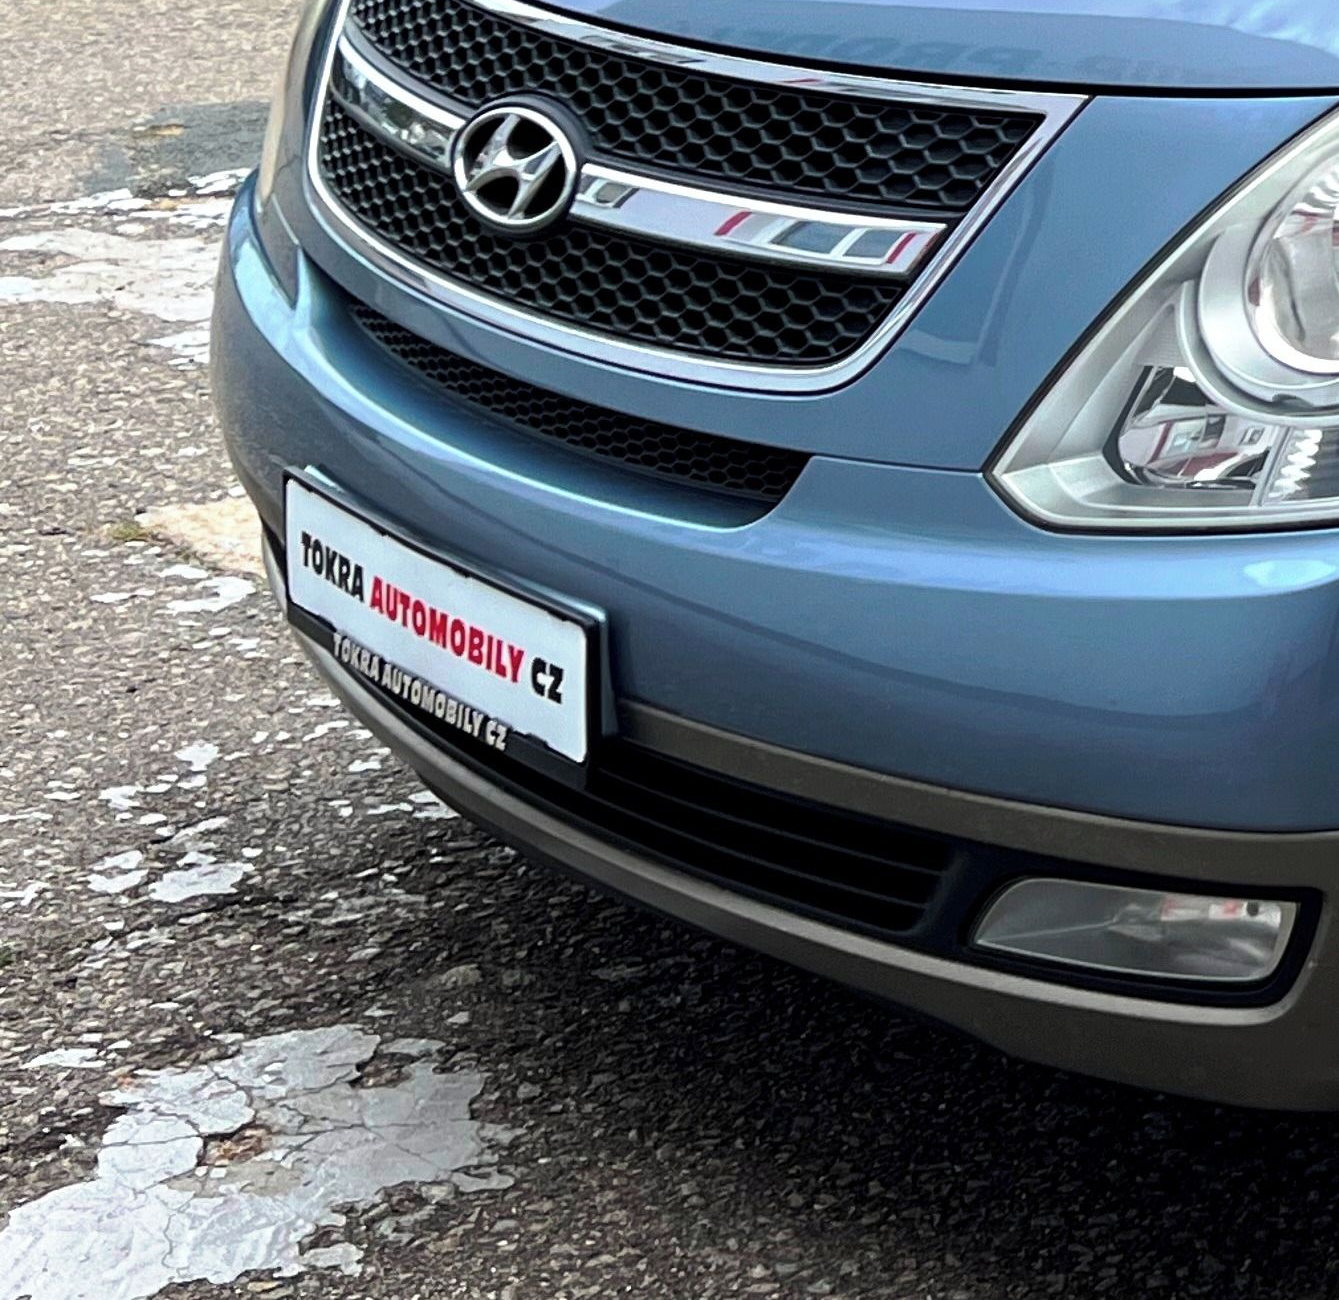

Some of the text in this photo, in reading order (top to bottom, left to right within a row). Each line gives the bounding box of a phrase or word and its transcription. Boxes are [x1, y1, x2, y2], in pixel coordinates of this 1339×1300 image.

[301, 531, 564, 704] TOKRA AUTOMOBILY CZ
[333, 632, 508, 751] TOKRA AUTOMOBILY CZ
